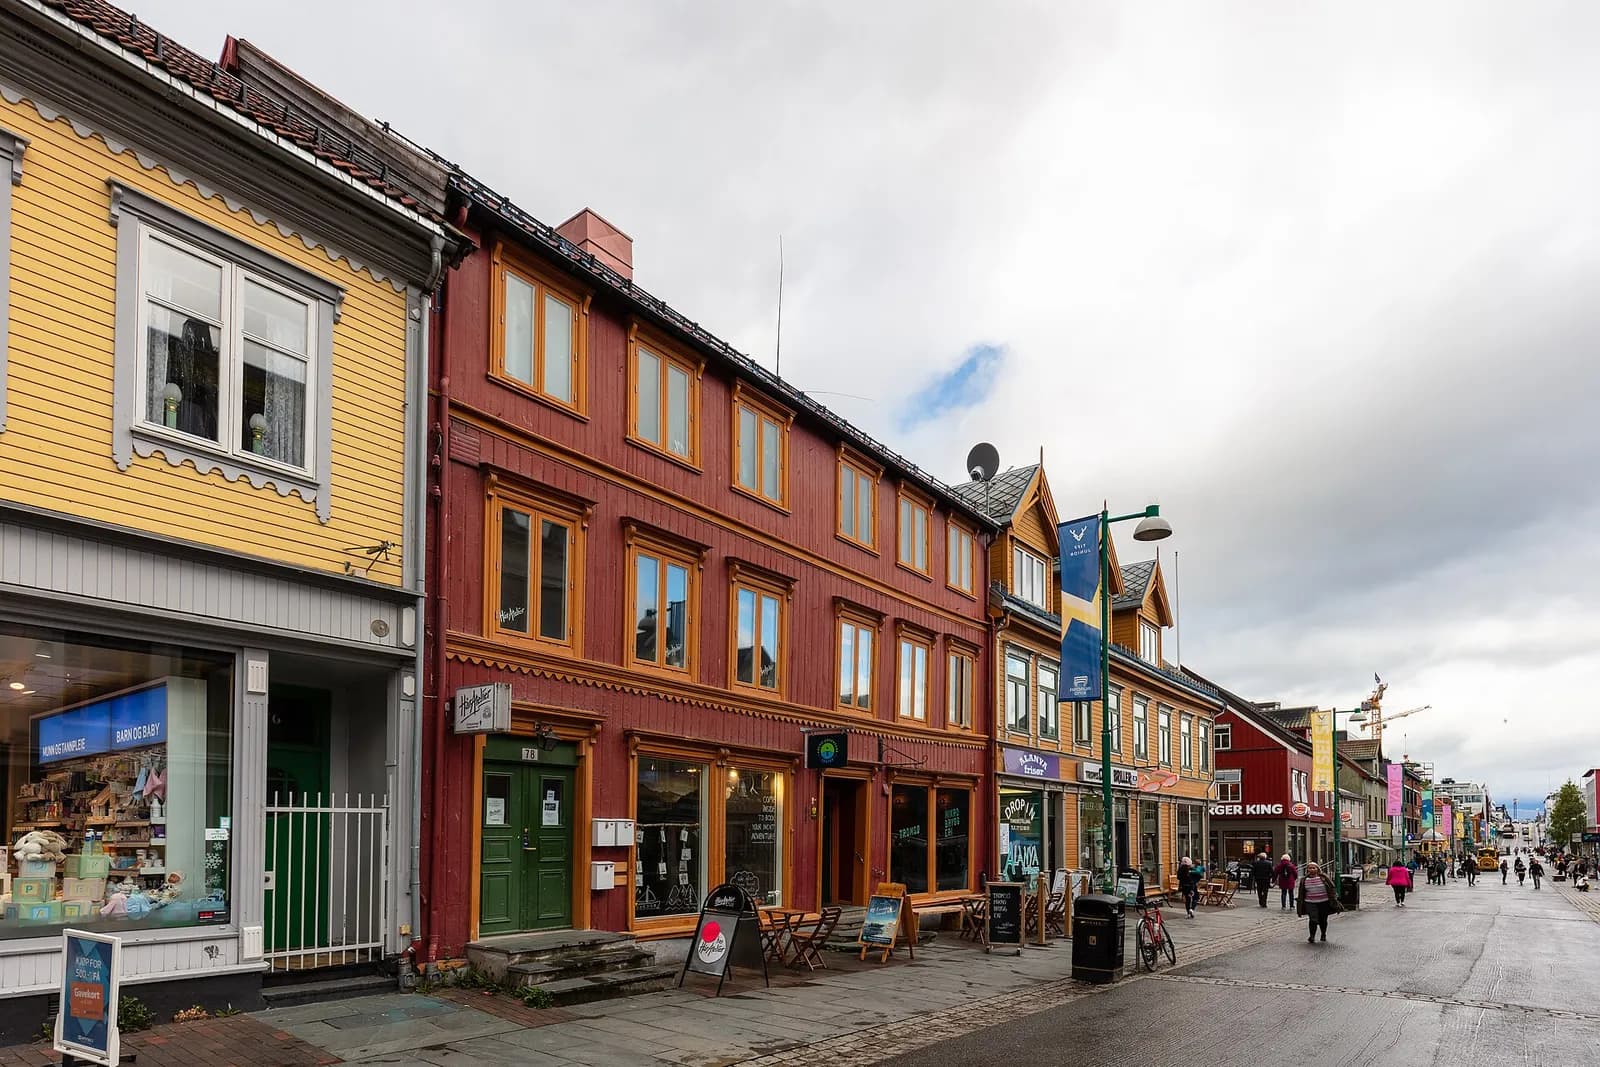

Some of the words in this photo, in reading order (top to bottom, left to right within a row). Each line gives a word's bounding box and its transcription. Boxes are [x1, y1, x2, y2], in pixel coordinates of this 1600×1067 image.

[116, 727, 133, 743] BARN
[133, 726, 143, 740] OG
[142, 722, 160, 739] BABY
[524, 749, 535, 760] 78
[1019, 754, 1048, 771] ALANYA
[1004, 798, 1026, 820] DROP
[1025, 801, 1036, 821] IN
[1246, 803, 1283, 815] KING
[1003, 841, 1039, 877] ALANYA
[89, 959, 102, 969] FOR
[74, 987, 100, 1000] Gavekort
